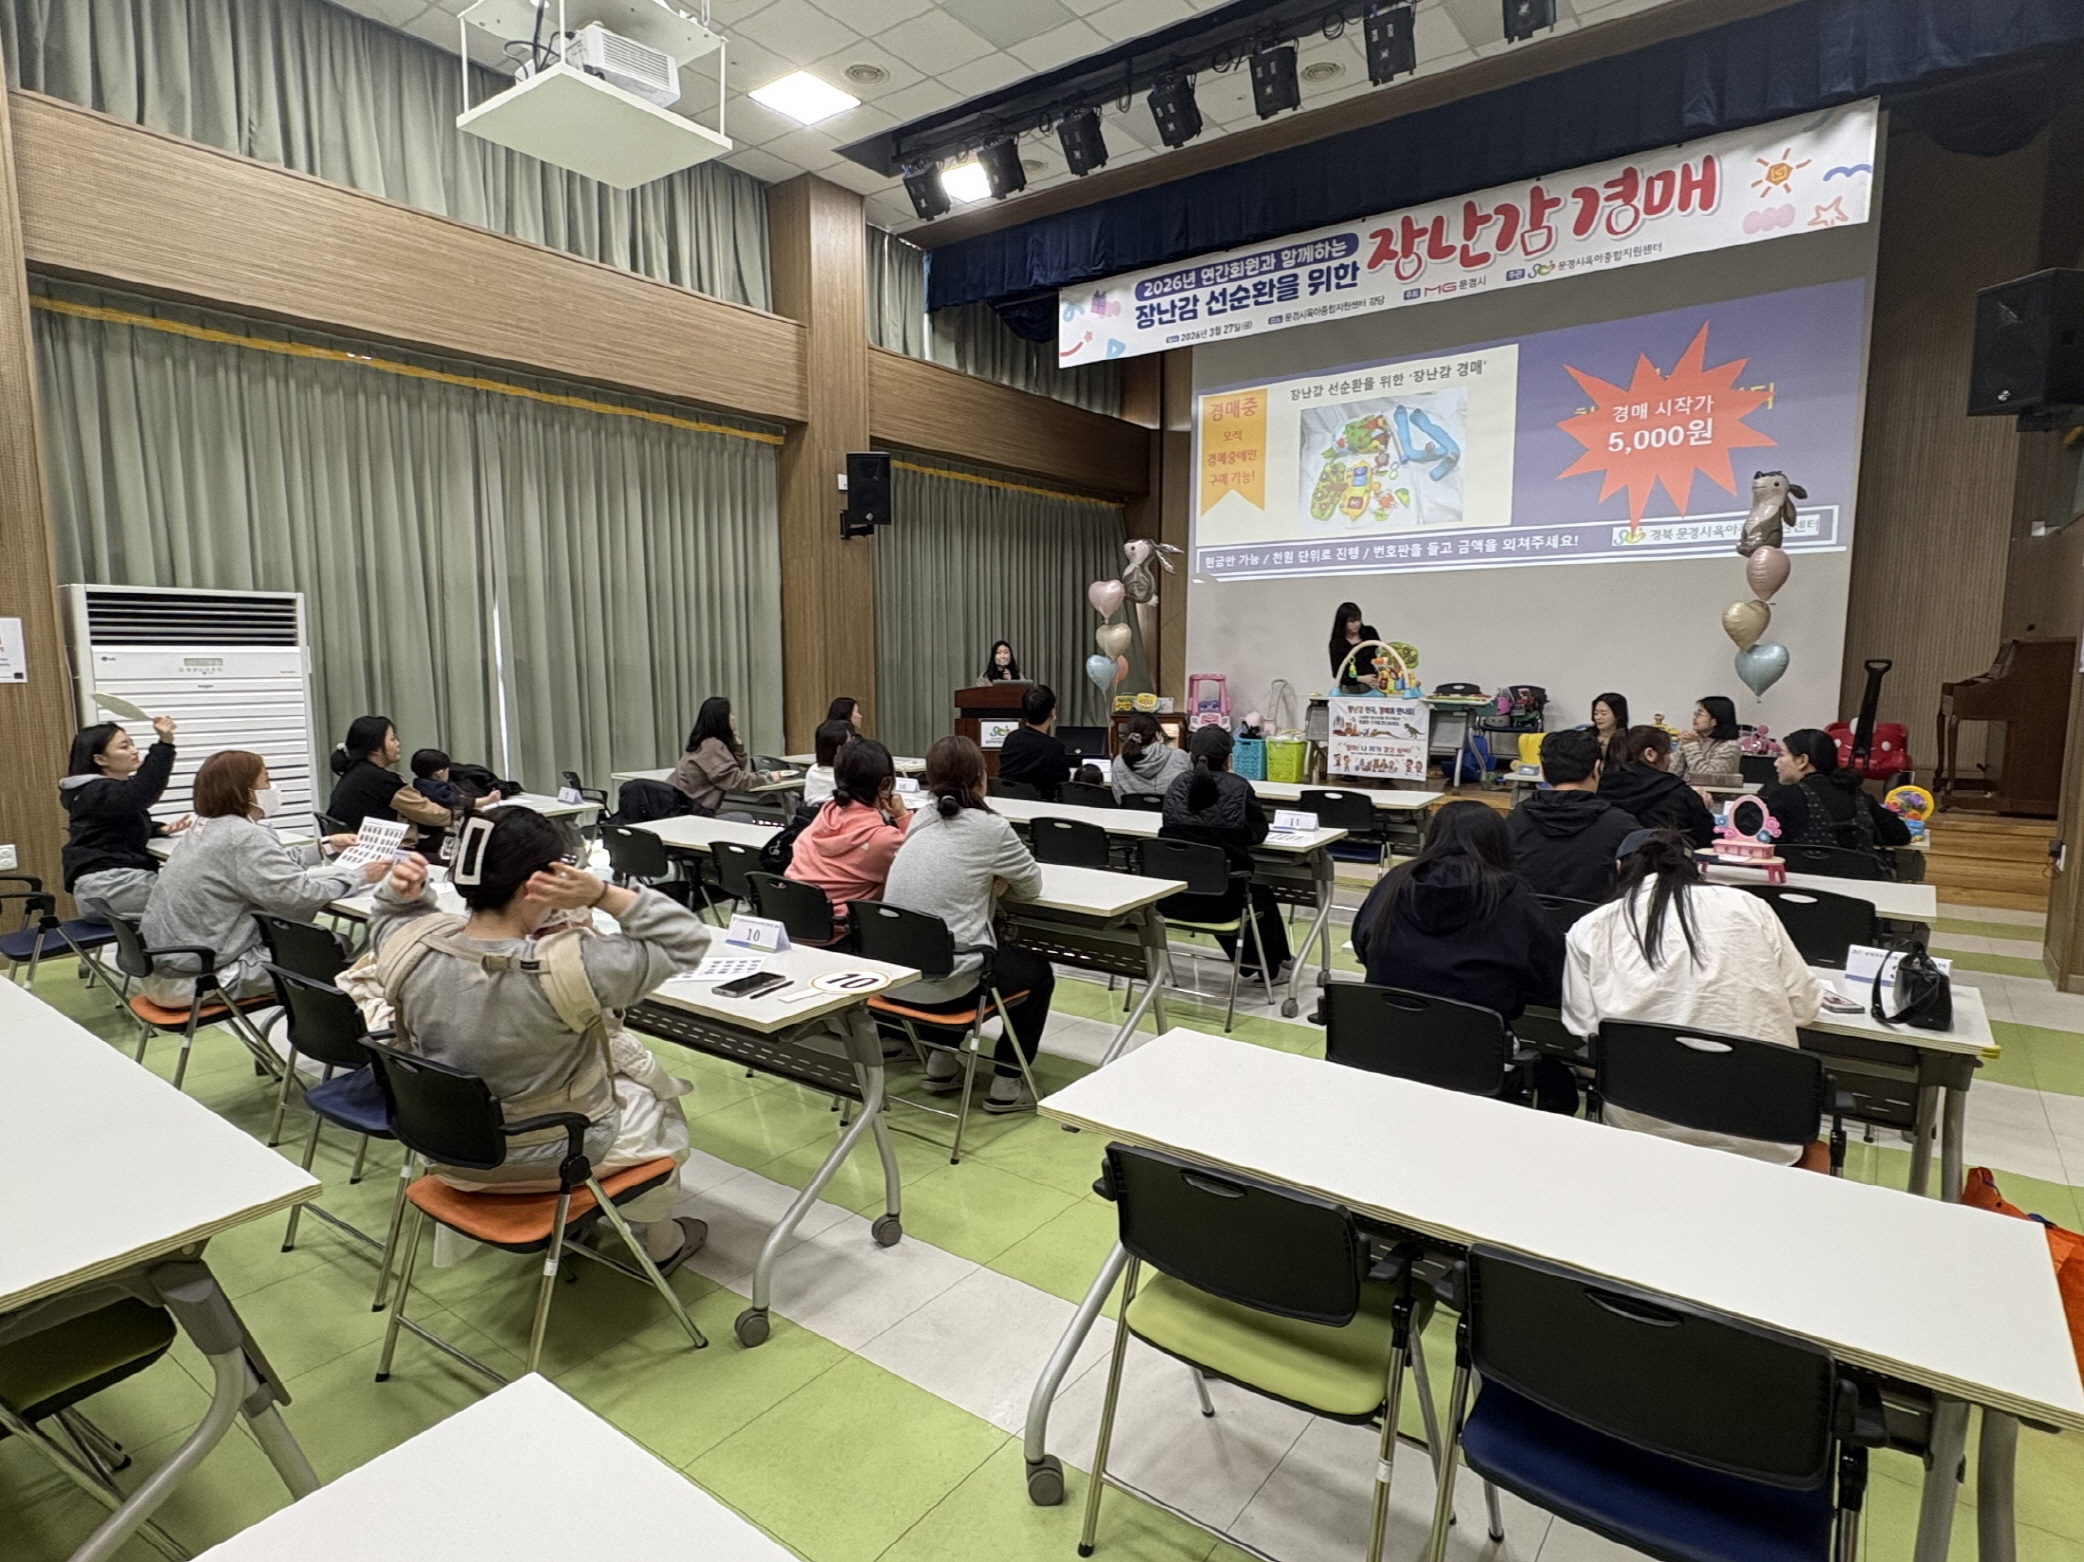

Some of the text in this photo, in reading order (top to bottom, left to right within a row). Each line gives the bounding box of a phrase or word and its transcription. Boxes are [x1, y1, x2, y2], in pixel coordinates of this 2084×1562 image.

[1367, 155, 1716, 281] 장난감 경매
[1144, 240, 1347, 297] 2026년 연간회원과 함께하는
[1558, 242, 1663, 271] 문경시육아종합지원센터
[1135, 261, 1360, 329] 장난감 선순환을 위한
[1424, 282, 1457, 297] MG
[1459, 276, 1487, 290] 문경시
[1181, 329, 1207, 341] 2026년
[1209, 326, 1221, 337] 3월
[1290, 385, 1324, 401] 장난감
[1328, 376, 1375, 396] 선순환을
[1379, 374, 1405, 389] 위한
[1208, 397, 1258, 422] 경매중
[1612, 402, 1649, 423] 경매
[1655, 395, 1715, 416] 시작가
[1222, 429, 1243, 442] 오직
[1607, 417, 1713, 455] 5,000원
[1207, 449, 1258, 467] 경매중에만
[1208, 470, 1255, 486] 구매 가능!
[1651, 527, 1673, 541] 경북
[1205, 555, 1236, 569] 현금만
[1238, 554, 1260, 567] 가능
[1272, 551, 1294, 565] 천원
[1298, 549, 1332, 563] 단위로
[1336, 546, 1359, 561] 진행
[1373, 543, 1422, 559] 번호판을
[1427, 541, 1453, 557] 들고
[1457, 538, 1498, 554] 금액을
[1502, 535, 1579, 551] 외쳐주세요!
[746, 928, 761, 942] 10
[826, 974, 880, 988] 10
